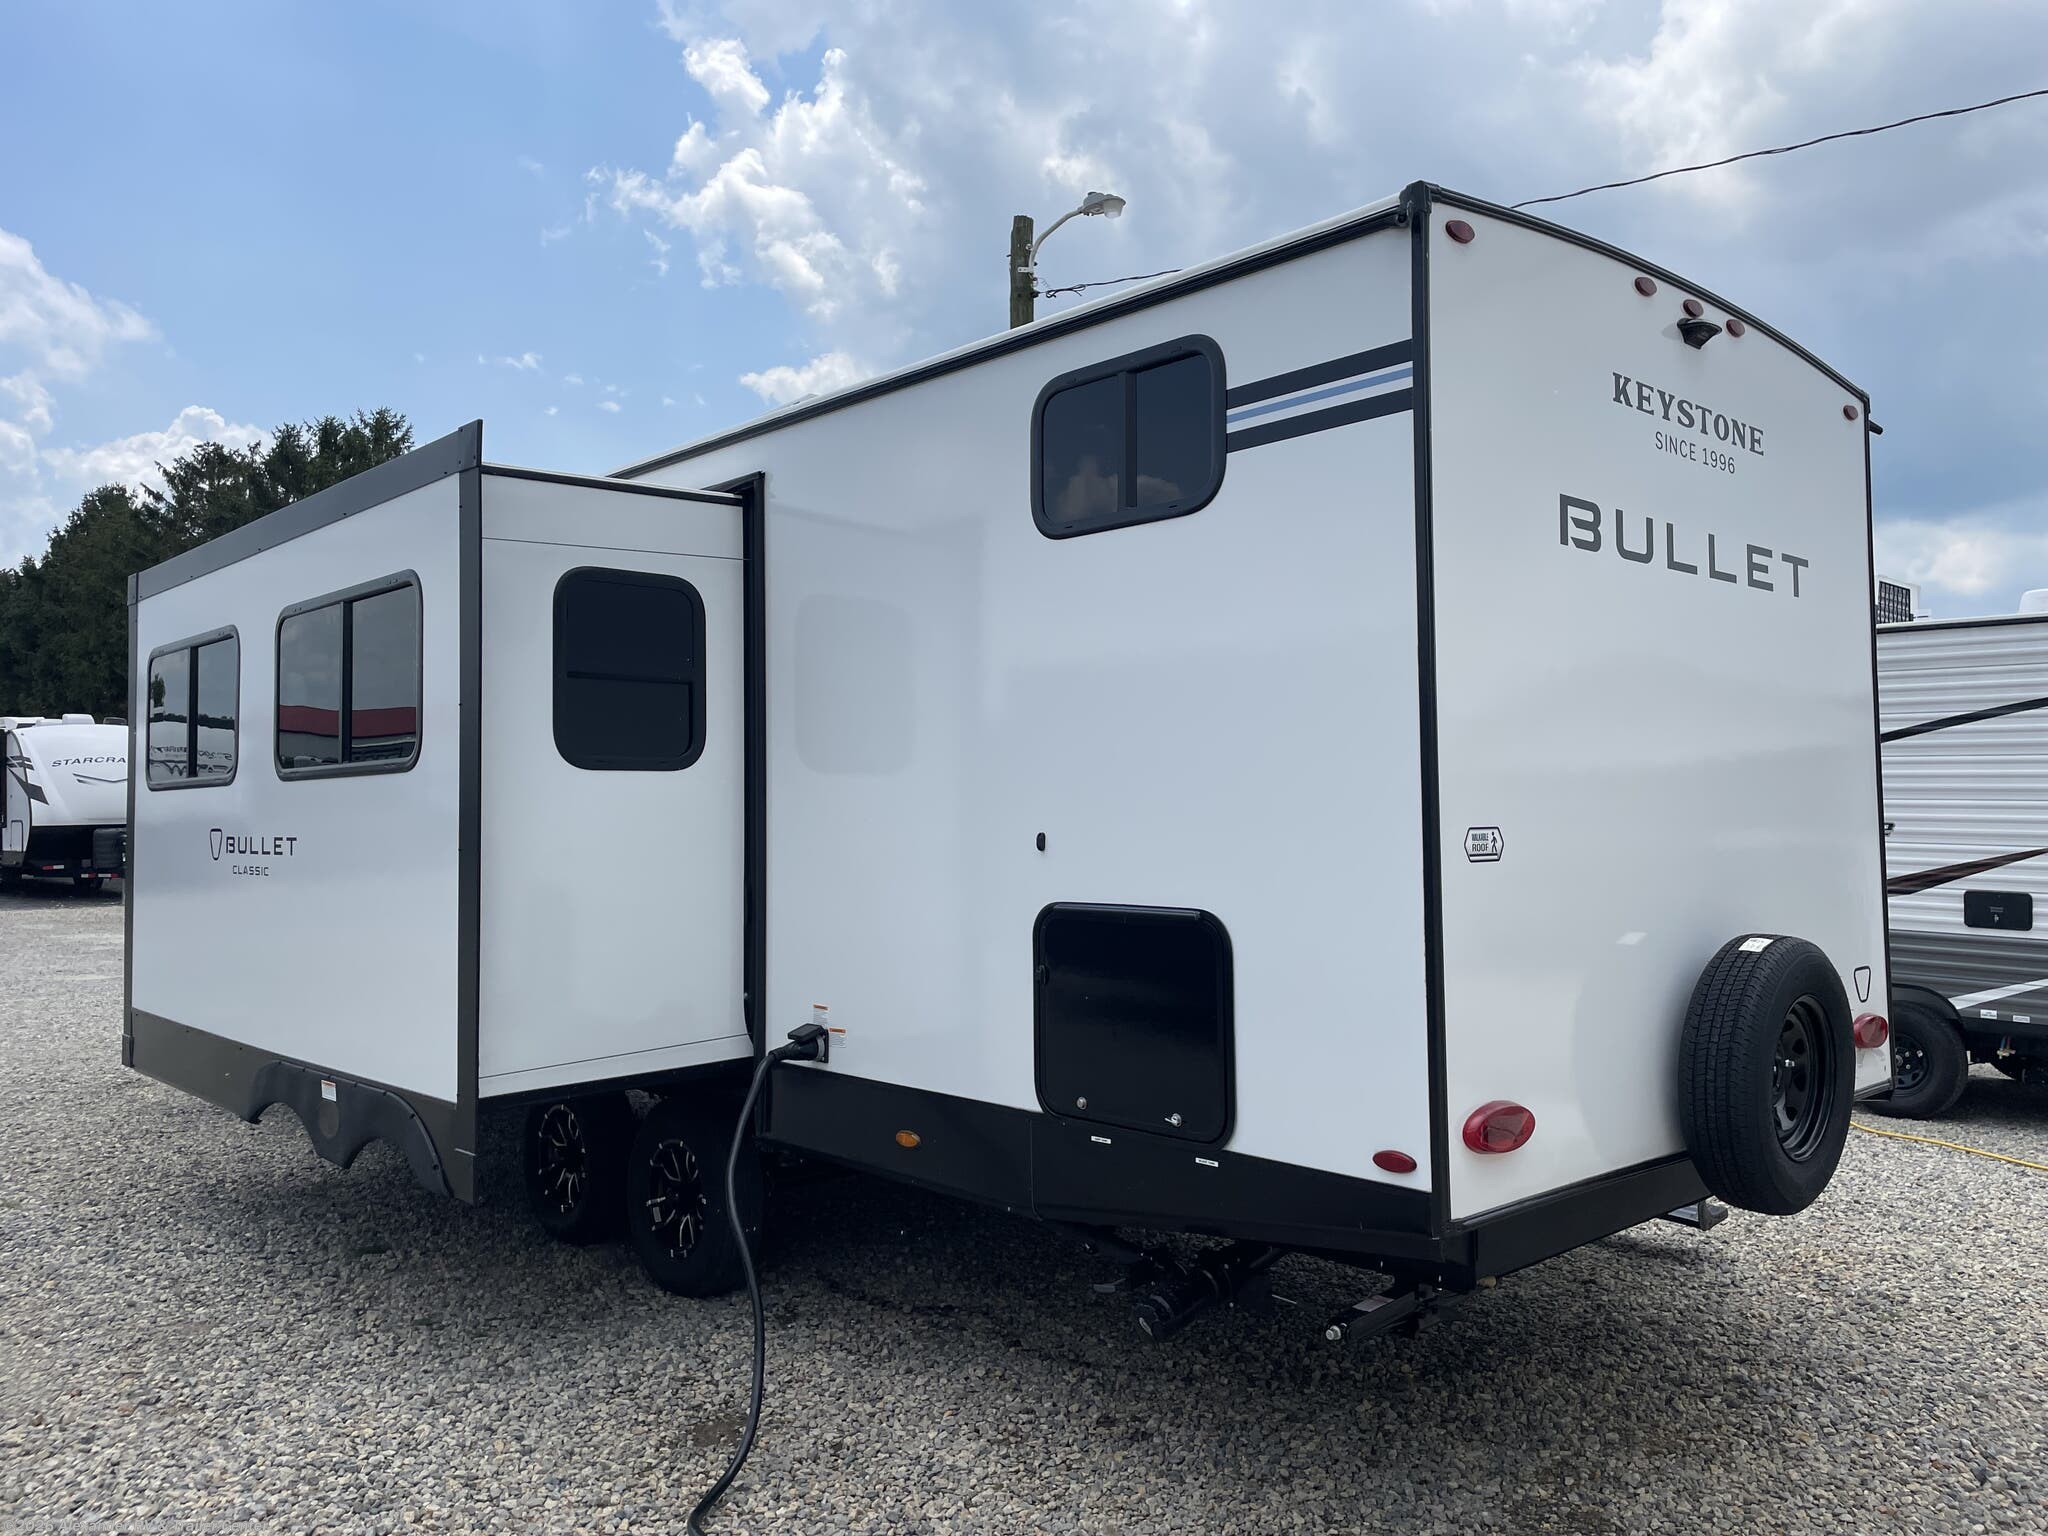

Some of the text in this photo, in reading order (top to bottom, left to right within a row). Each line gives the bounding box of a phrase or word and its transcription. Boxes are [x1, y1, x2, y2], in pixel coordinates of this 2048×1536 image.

[1612, 372, 1764, 456] KEYSTONE
[1655, 431, 1736, 474] SINCE 1996
[1560, 493, 1809, 598] BULLET
[226, 836, 297, 856] BULLET
[1472, 843, 1488, 852] ROOF
[232, 865, 269, 877] CLASSIC
